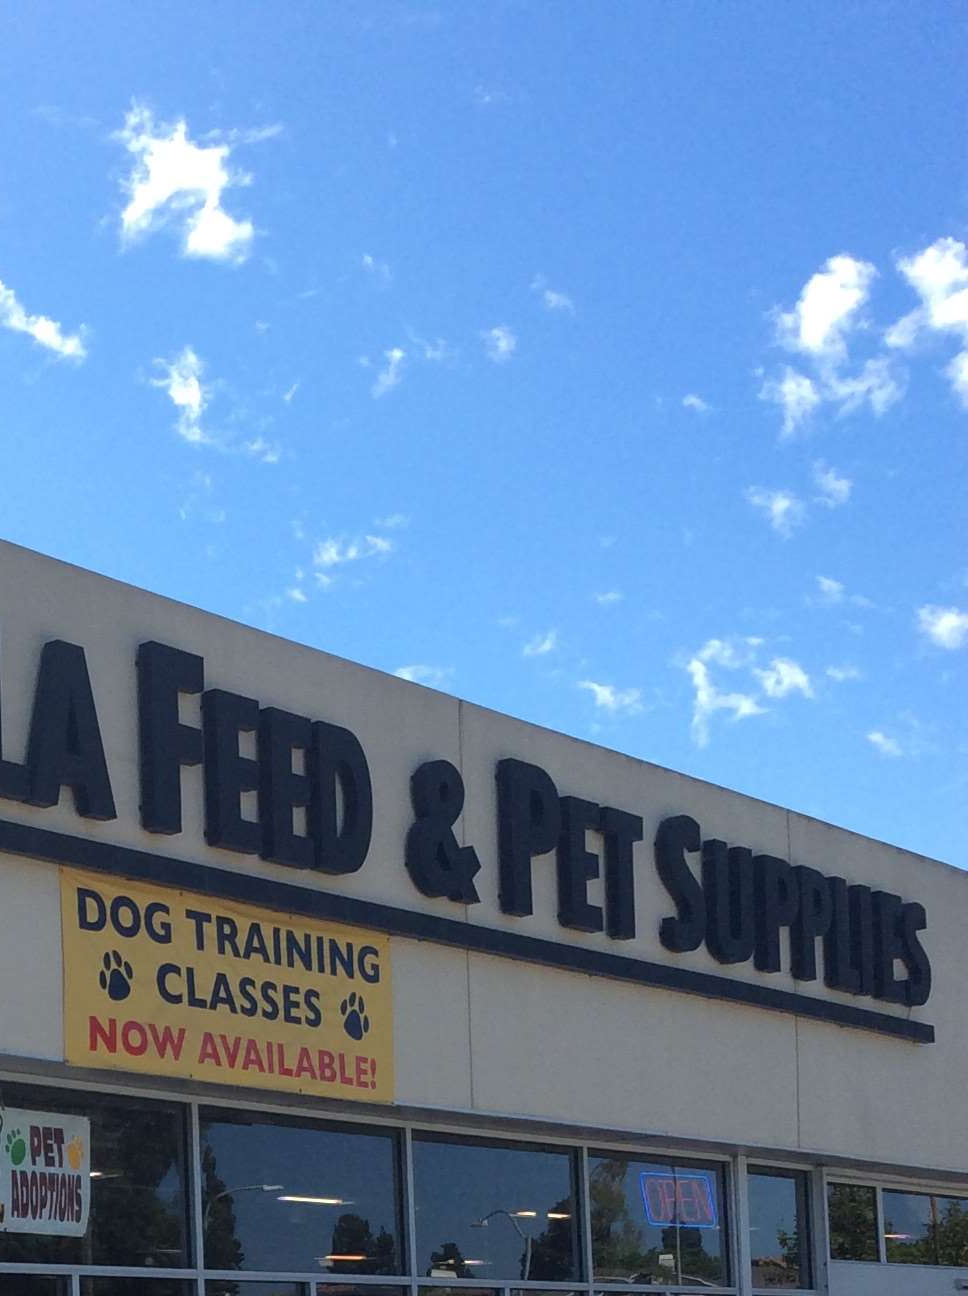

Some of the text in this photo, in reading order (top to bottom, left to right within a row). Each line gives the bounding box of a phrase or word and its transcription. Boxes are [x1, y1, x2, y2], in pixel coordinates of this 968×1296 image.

[136, 640, 373, 876] FEED
[405, 759, 481, 904] &
[495, 757, 643, 940] PET
[654, 815, 931, 1007] SUPPLIES
[77, 887, 380, 983] DOG TRAINING
[156, 963, 322, 1028] CLASSES
[89, 1015, 377, 1090] NOW AVAILABLE!
[30, 1125, 65, 1168] PET
[11, 1169, 82, 1224] ADOPTIONS
[645, 1178, 713, 1222] OPEN
